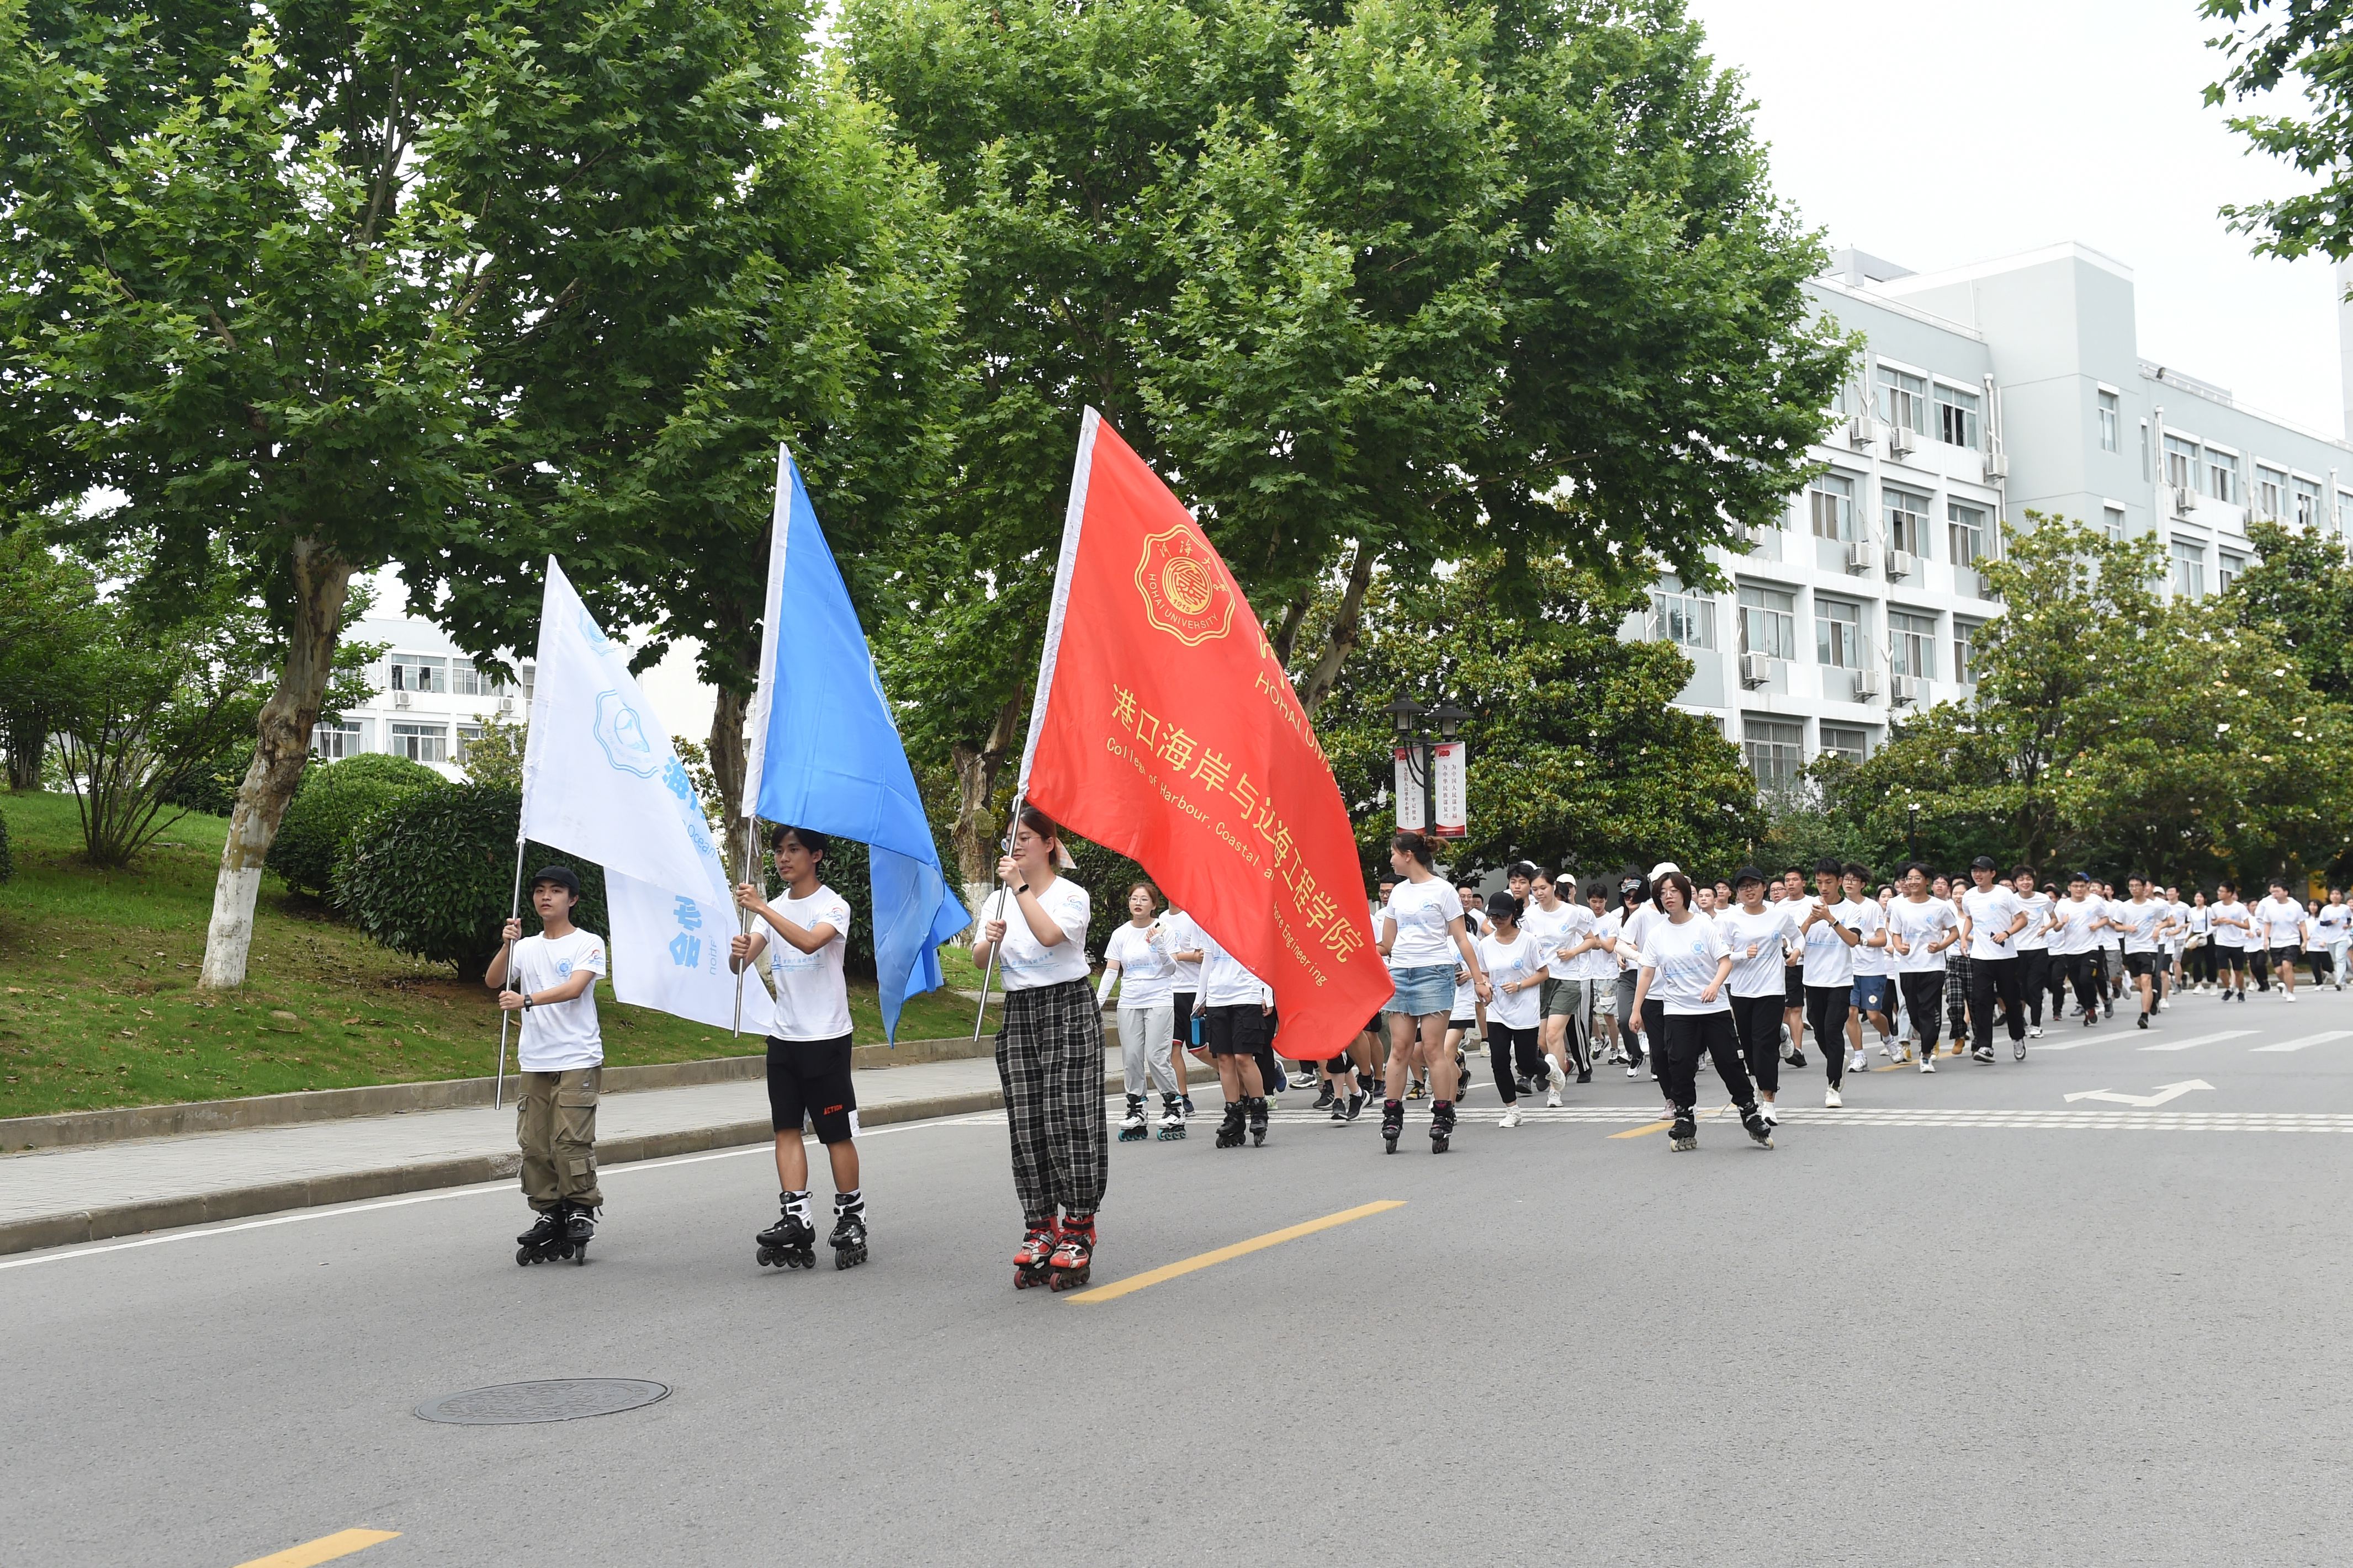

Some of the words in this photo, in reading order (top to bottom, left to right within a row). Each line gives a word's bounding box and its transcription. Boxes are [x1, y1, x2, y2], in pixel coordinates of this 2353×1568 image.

[1148, 573, 1165, 610] HOHAI
[1164, 608, 1218, 629] UNIVERSITY
[1173, 599, 1191, 612] 1915
[1255, 671, 1301, 733] HOHAI
[687, 824, 716, 859] Ocean
[1149, 774, 1158, 788] of
[1216, 821, 1261, 867] Coastal
[1282, 923, 1328, 987] Engineering
[823, 1104, 843, 1115] ACTION
